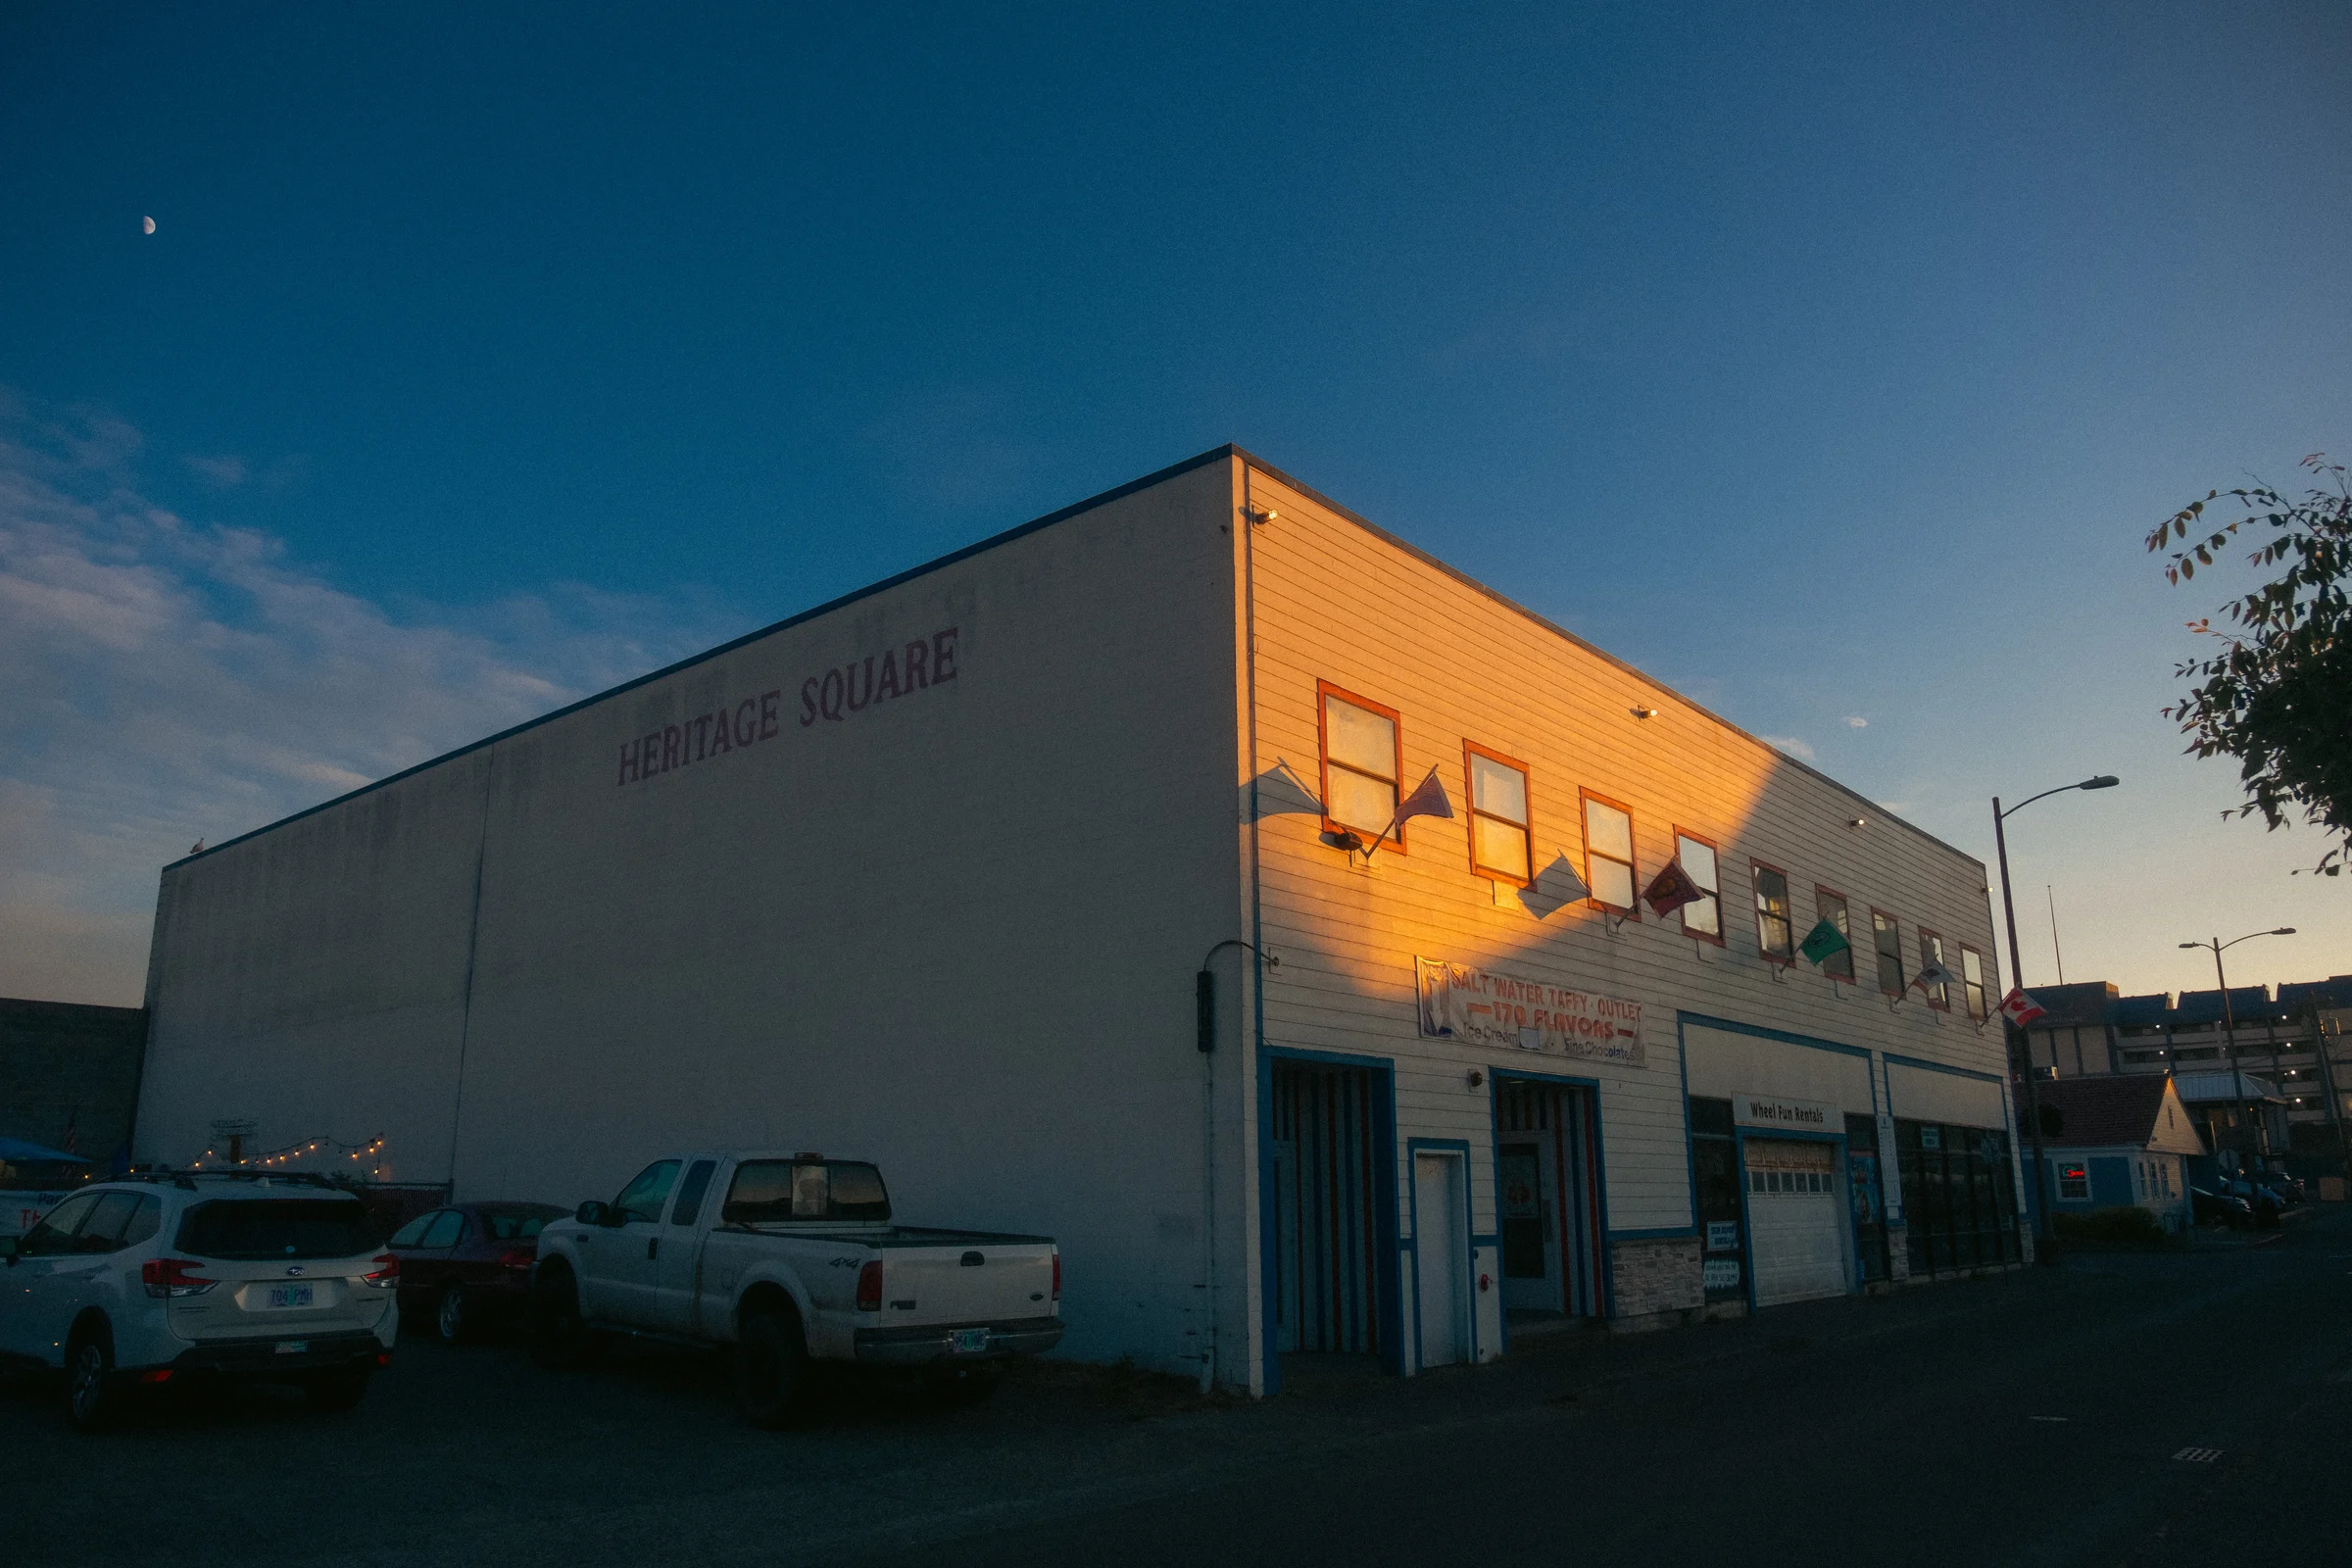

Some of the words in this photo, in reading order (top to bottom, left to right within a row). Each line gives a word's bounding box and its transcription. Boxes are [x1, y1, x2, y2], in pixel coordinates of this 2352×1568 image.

[617, 689, 781, 786] HERITAGE
[800, 627, 959, 728] SQUARE
[1450, 968, 1489, 995] SALT
[1494, 977, 1544, 1005] WATER
[1548, 988, 1588, 1012] TAFFY
[1597, 998, 1642, 1023] OUTLET
[1493, 1001, 1527, 1026] 170
[1534, 1008, 1614, 1041] FLAVORS
[1463, 1022, 1484, 1040] Ice
[1484, 1025, 1518, 1048] Cream
[1565, 1038, 1584, 1054] Fine
[1585, 1041, 1636, 1061] Chocolates
[1749, 1101, 1776, 1118] Wheel
[1778, 1104, 1793, 1122] Fun
[1794, 1105, 1824, 1123] Rentals
